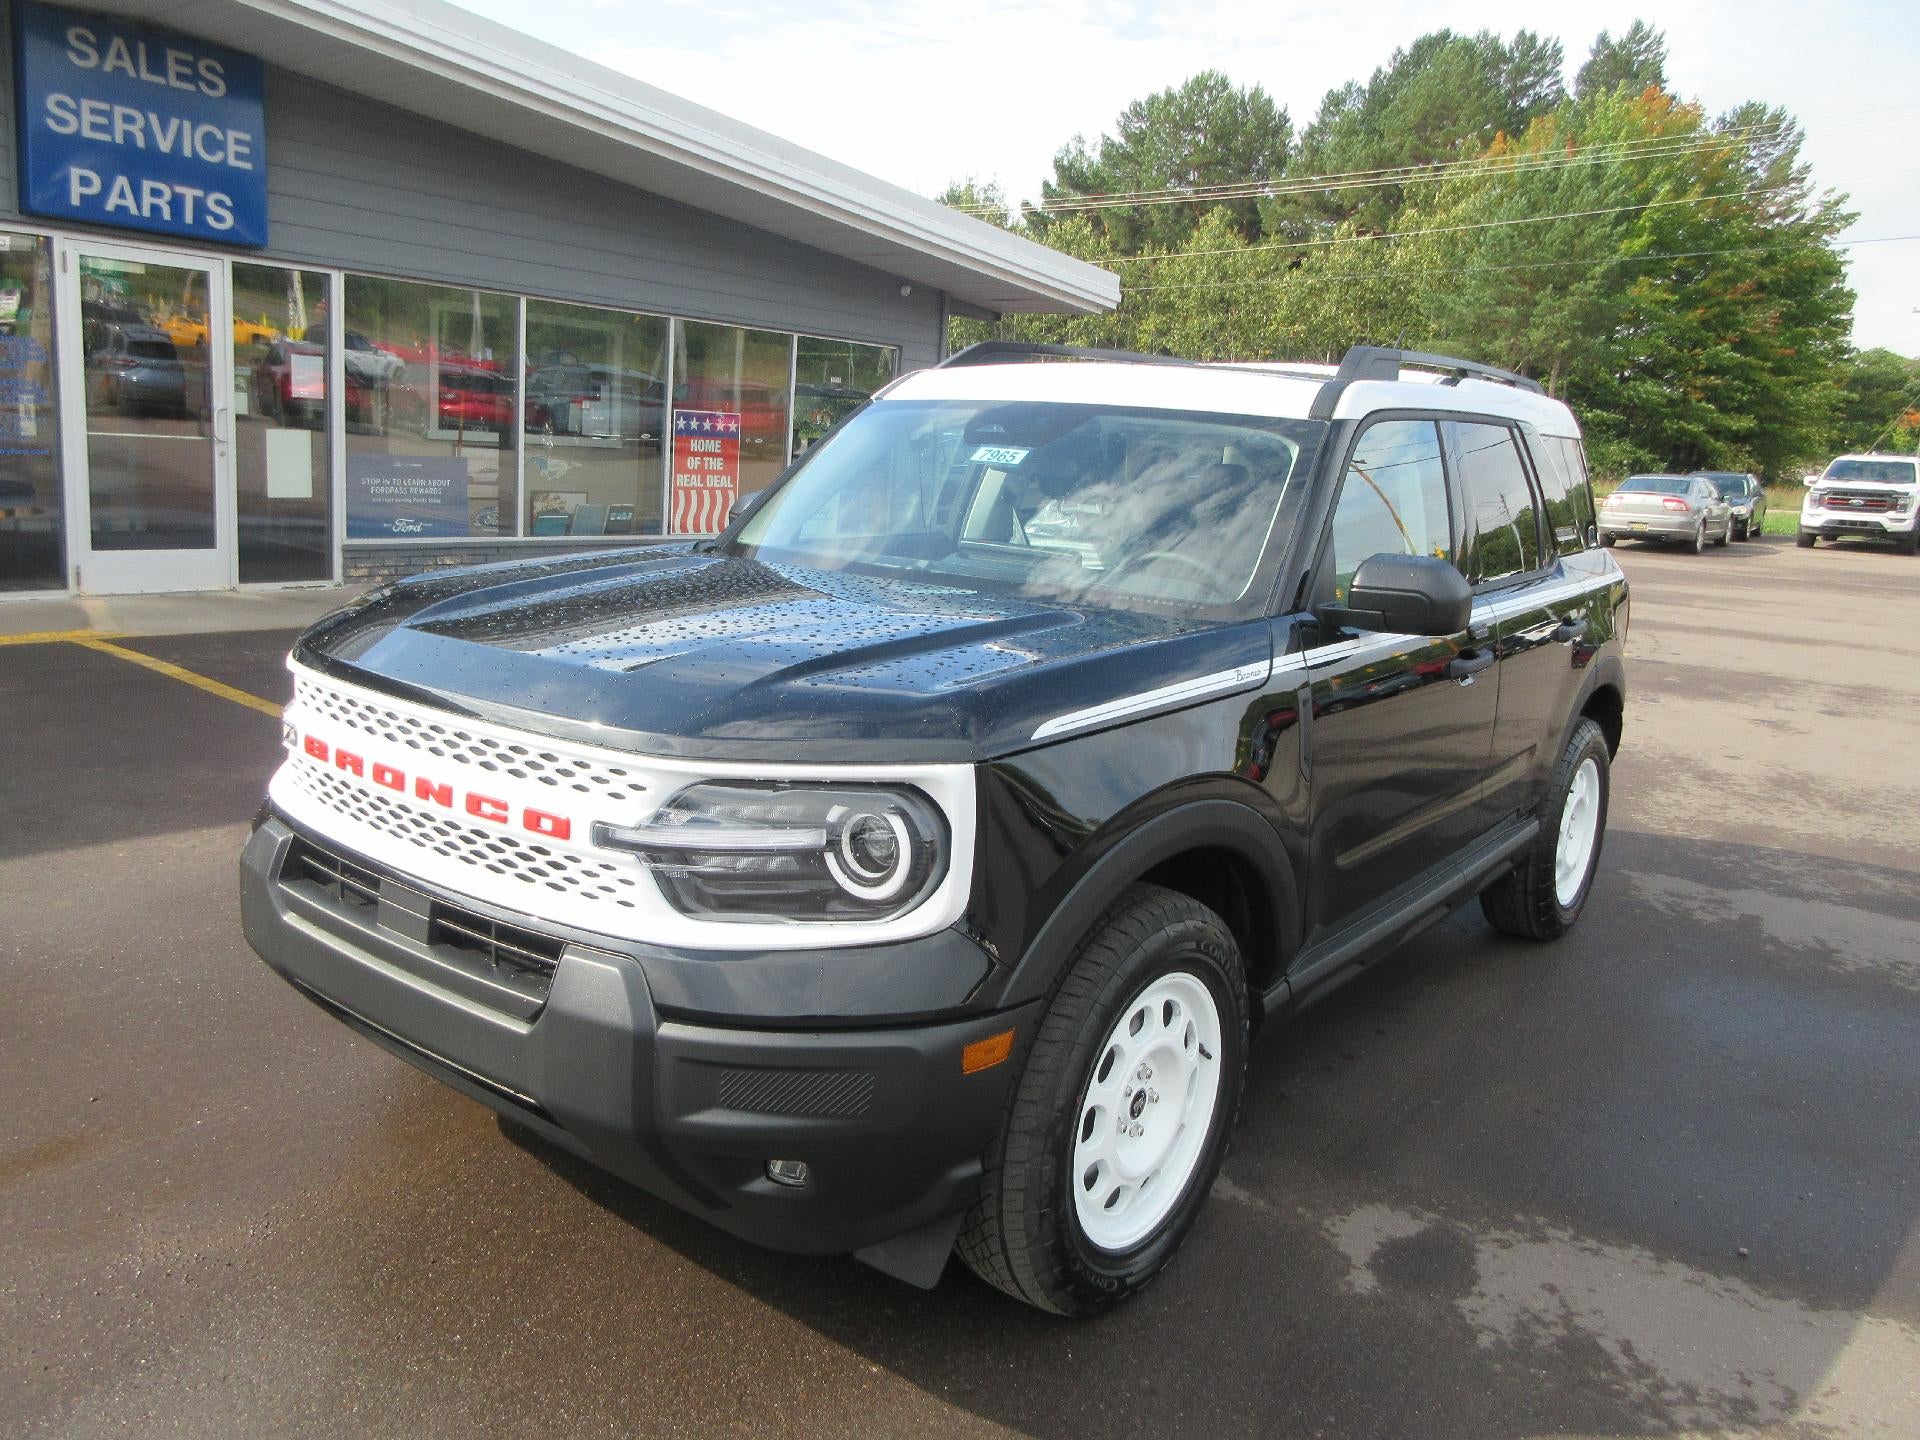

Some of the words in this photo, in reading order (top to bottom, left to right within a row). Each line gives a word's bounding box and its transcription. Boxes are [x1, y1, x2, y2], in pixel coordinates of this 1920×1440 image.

[66, 26, 227, 98] SALES
[45, 93, 254, 171] SERVICE
[69, 167, 235, 231] PARTS
[690, 439, 722, 453] HOME
[687, 456, 702, 470] OF
[703, 456, 724, 470] THE
[978, 449, 1020, 463] 7965
[361, 478, 381, 486] STOP
[382, 478, 390, 486] IN
[393, 478, 402, 486] TO
[403, 478, 426, 487] LEARN
[428, 479, 451, 487] ABOUT
[676, 473, 704, 487] REAL
[706, 474, 734, 488] DEAL
[370, 486, 408, 495] FORDPASS
[409, 487, 442, 495] REWARDS
[392, 518, 423, 532] Ford
[1234, 669, 1262, 682] Bronco
[304, 734, 571, 841] BRONCO
